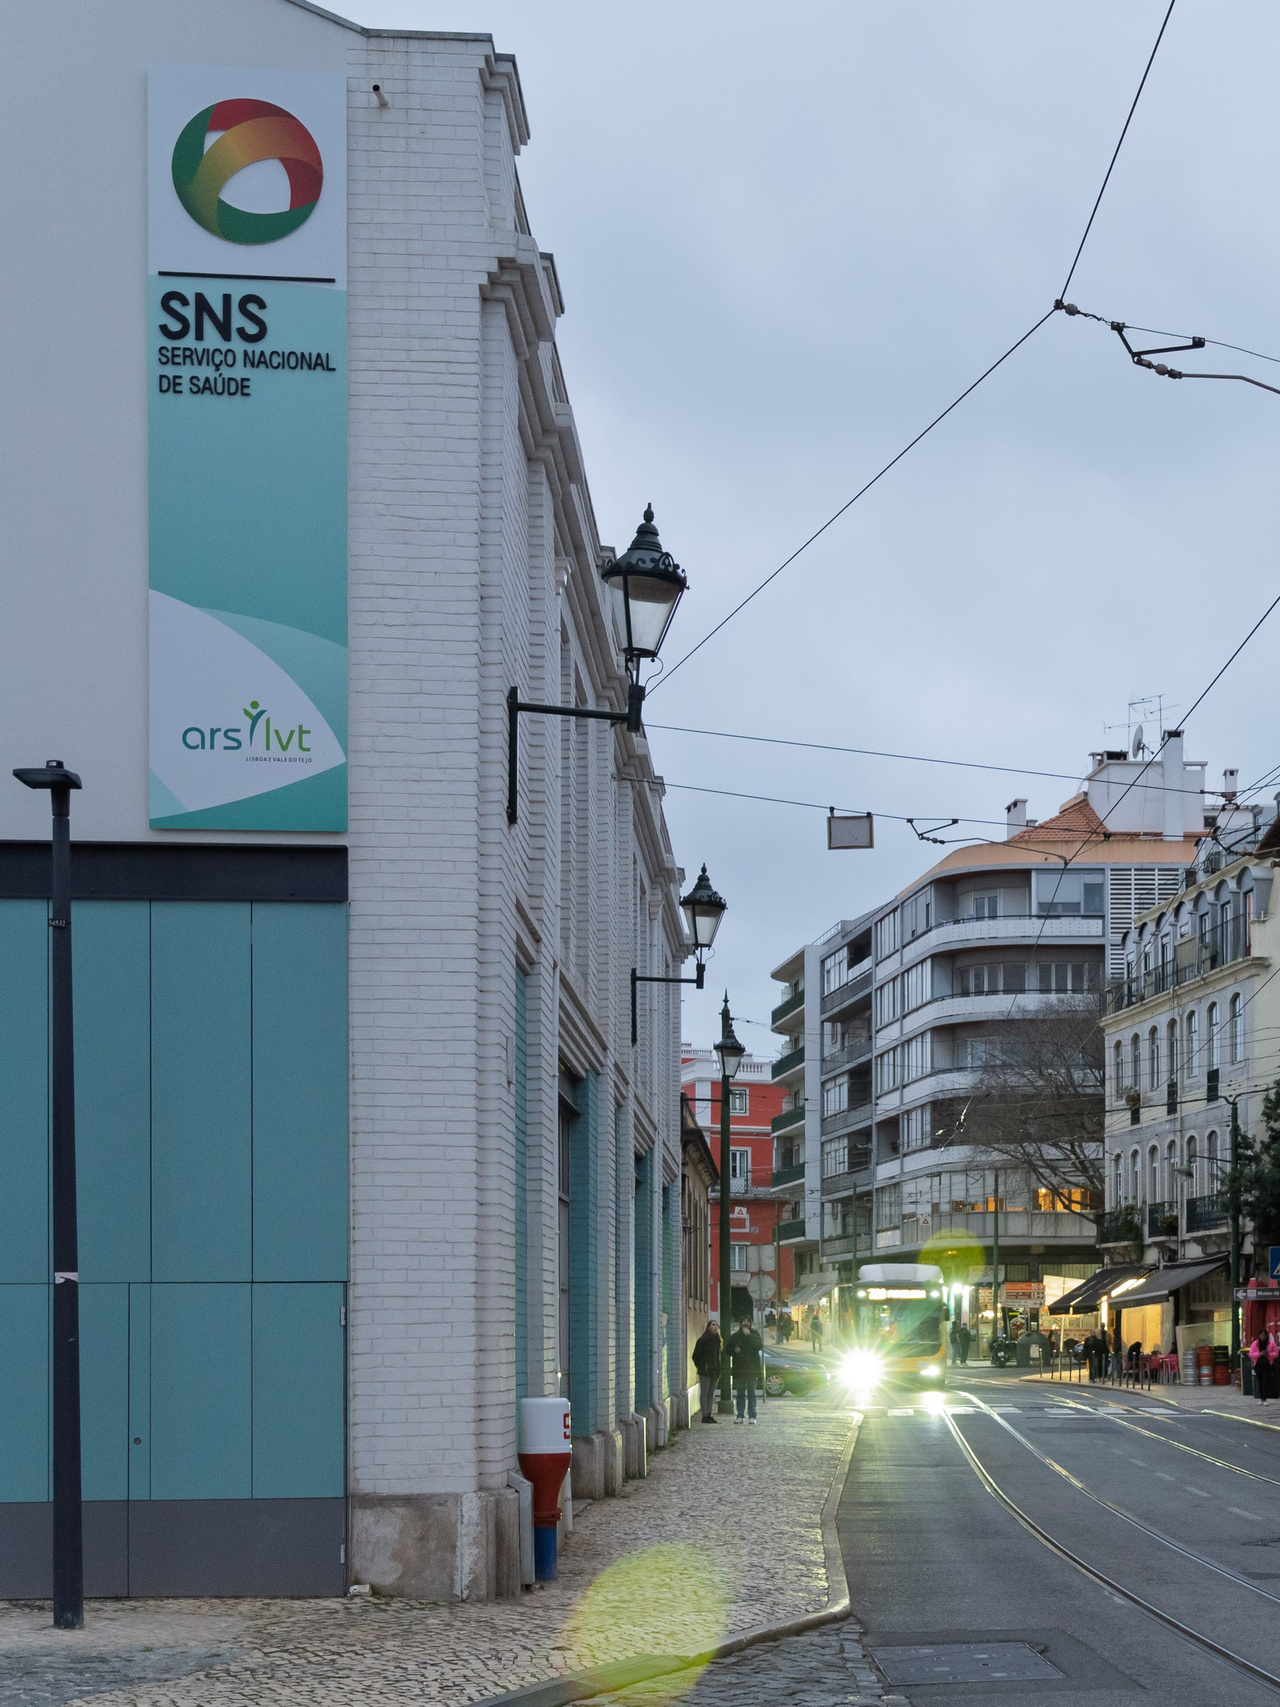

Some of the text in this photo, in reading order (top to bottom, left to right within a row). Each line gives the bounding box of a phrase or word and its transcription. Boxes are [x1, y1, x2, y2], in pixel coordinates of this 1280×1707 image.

[158, 290, 268, 343] SNS
[158, 346, 336, 372] SERVIÇO NACIONAL
[159, 373, 251, 397] DE SAÚDE
[181, 726, 243, 751] ars
